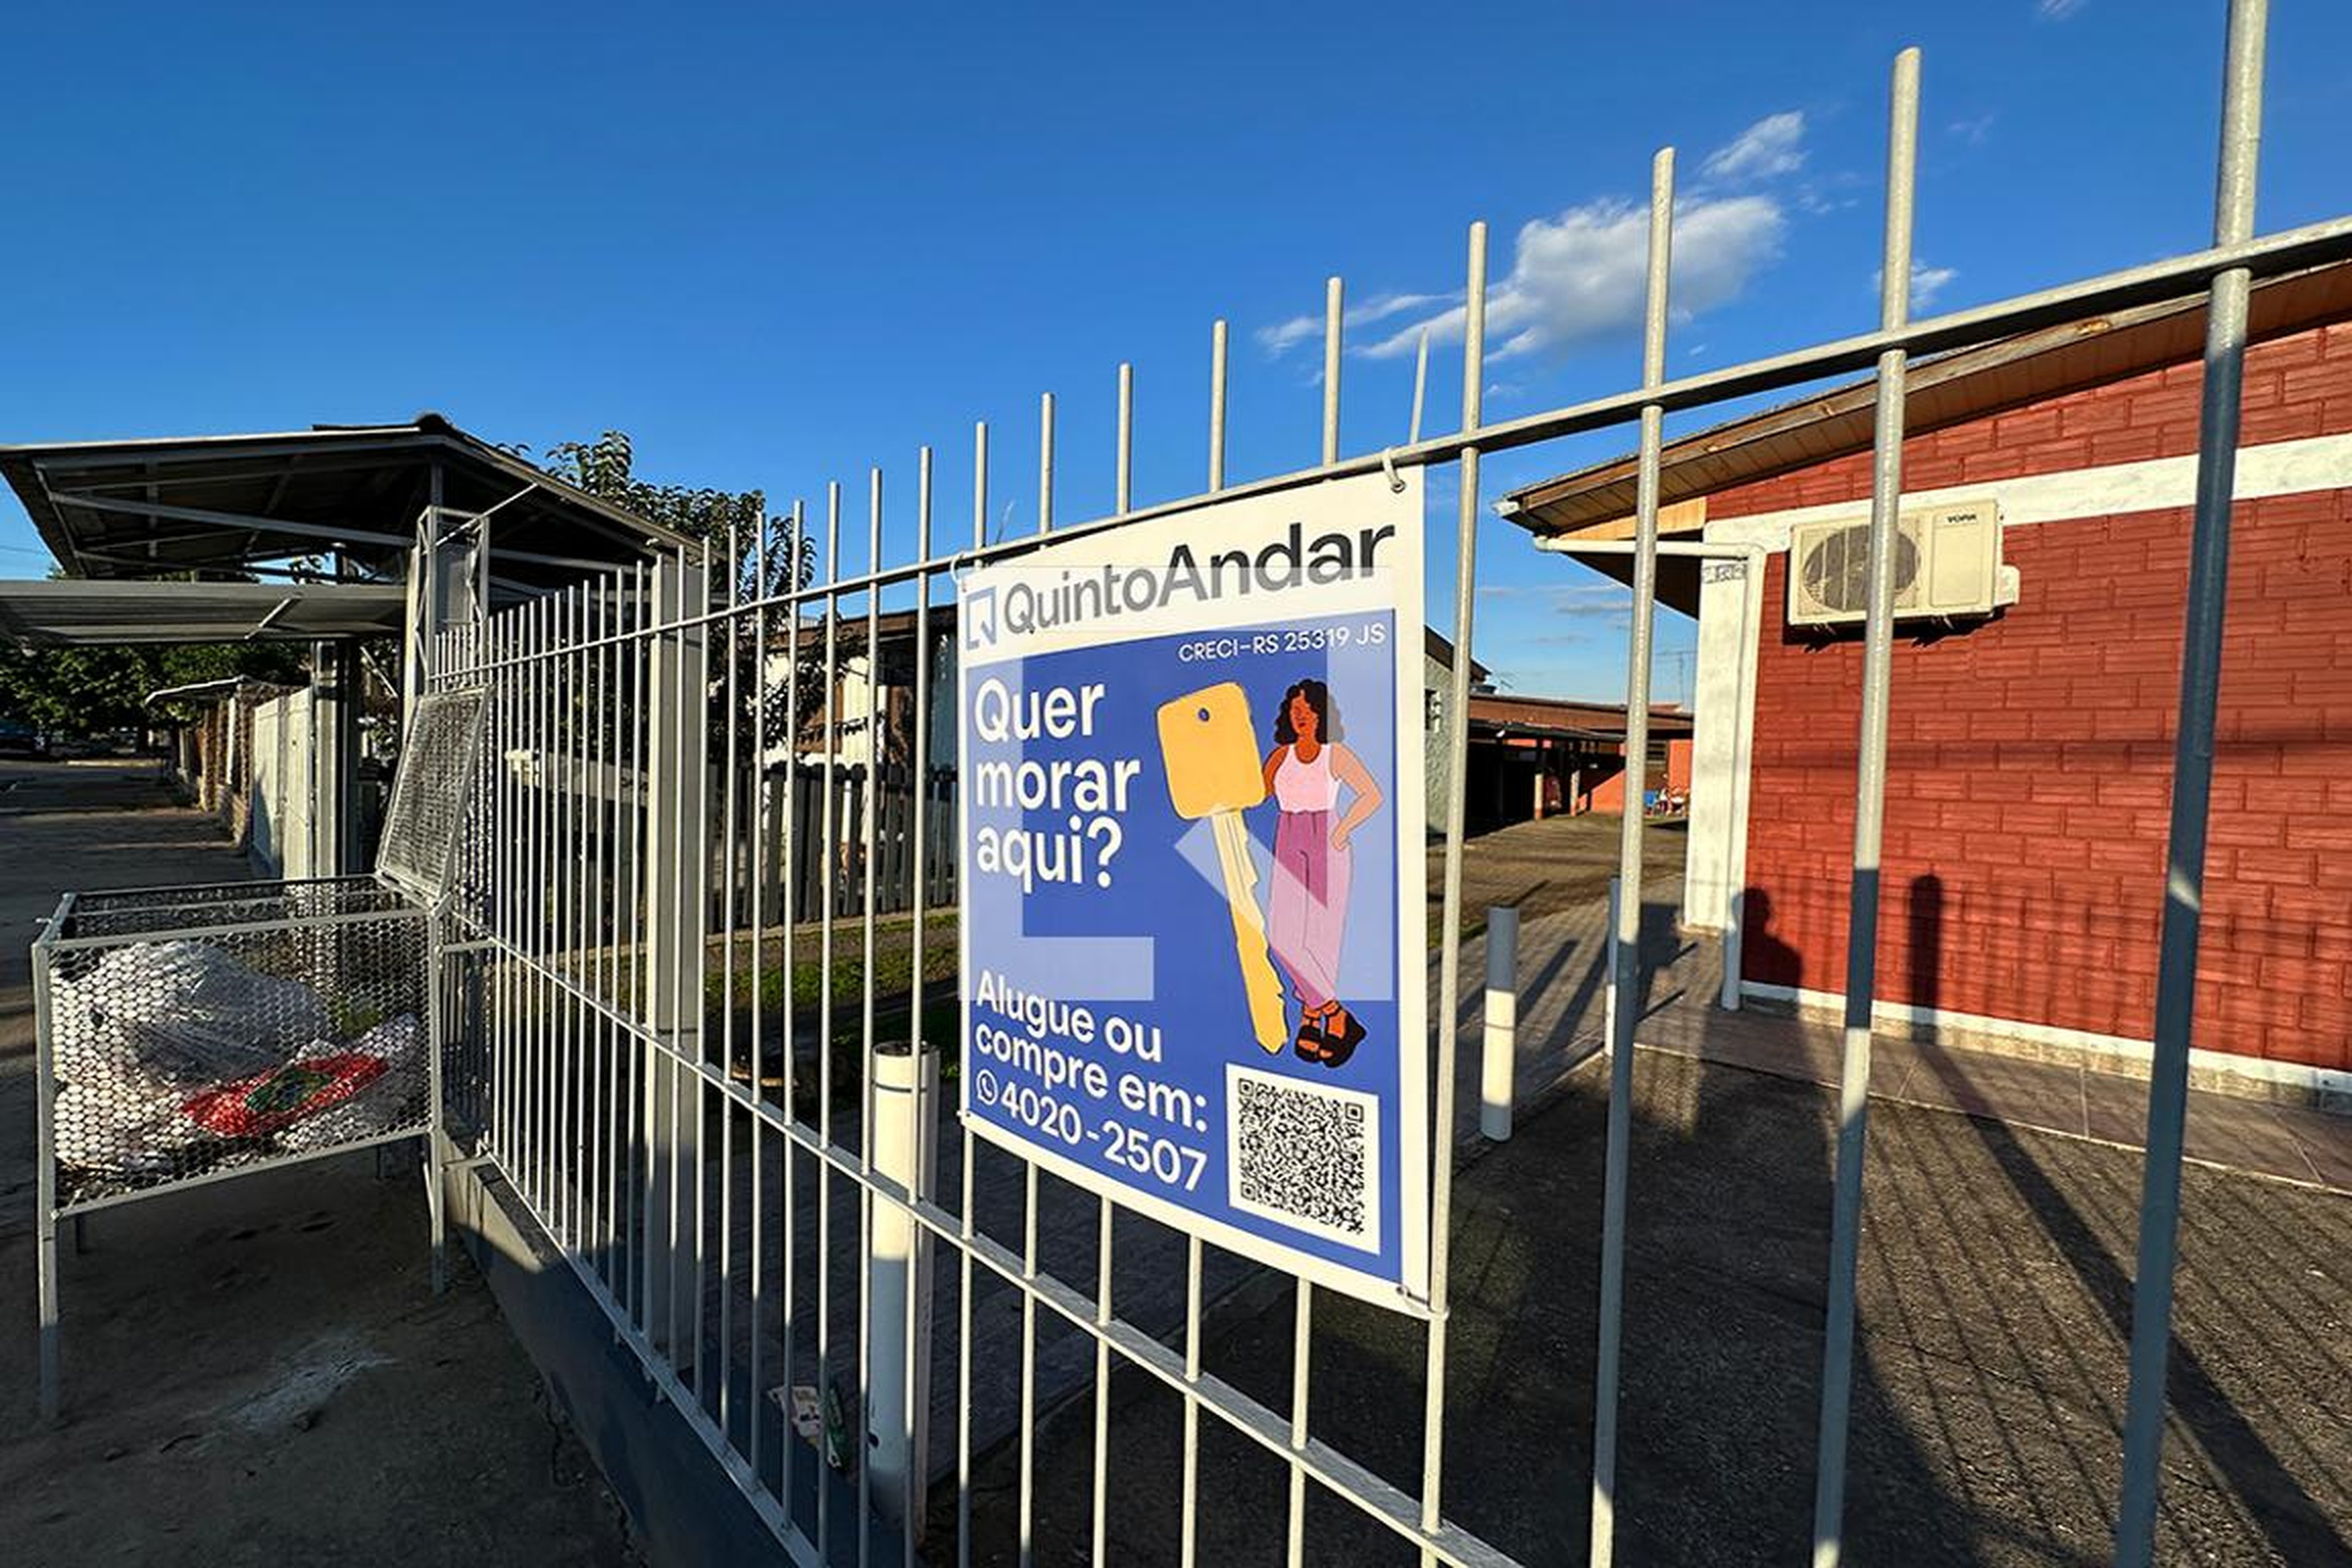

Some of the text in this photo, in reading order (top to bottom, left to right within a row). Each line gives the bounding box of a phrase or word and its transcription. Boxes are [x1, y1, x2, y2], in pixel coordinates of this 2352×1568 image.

[1005, 522, 1395, 633] QuintoAndar
[1284, 627, 1349, 653] 25319
[1355, 622, 1386, 646] JS
[974, 680, 1105, 742] Quer
[976, 758, 1140, 812] morar
[976, 816, 1123, 894] aqui?
[977, 970, 1162, 1062] Alugue ou
[976, 1023, 1208, 1133] compre em:
[1001, 1082, 1208, 1192] 4020-2507
